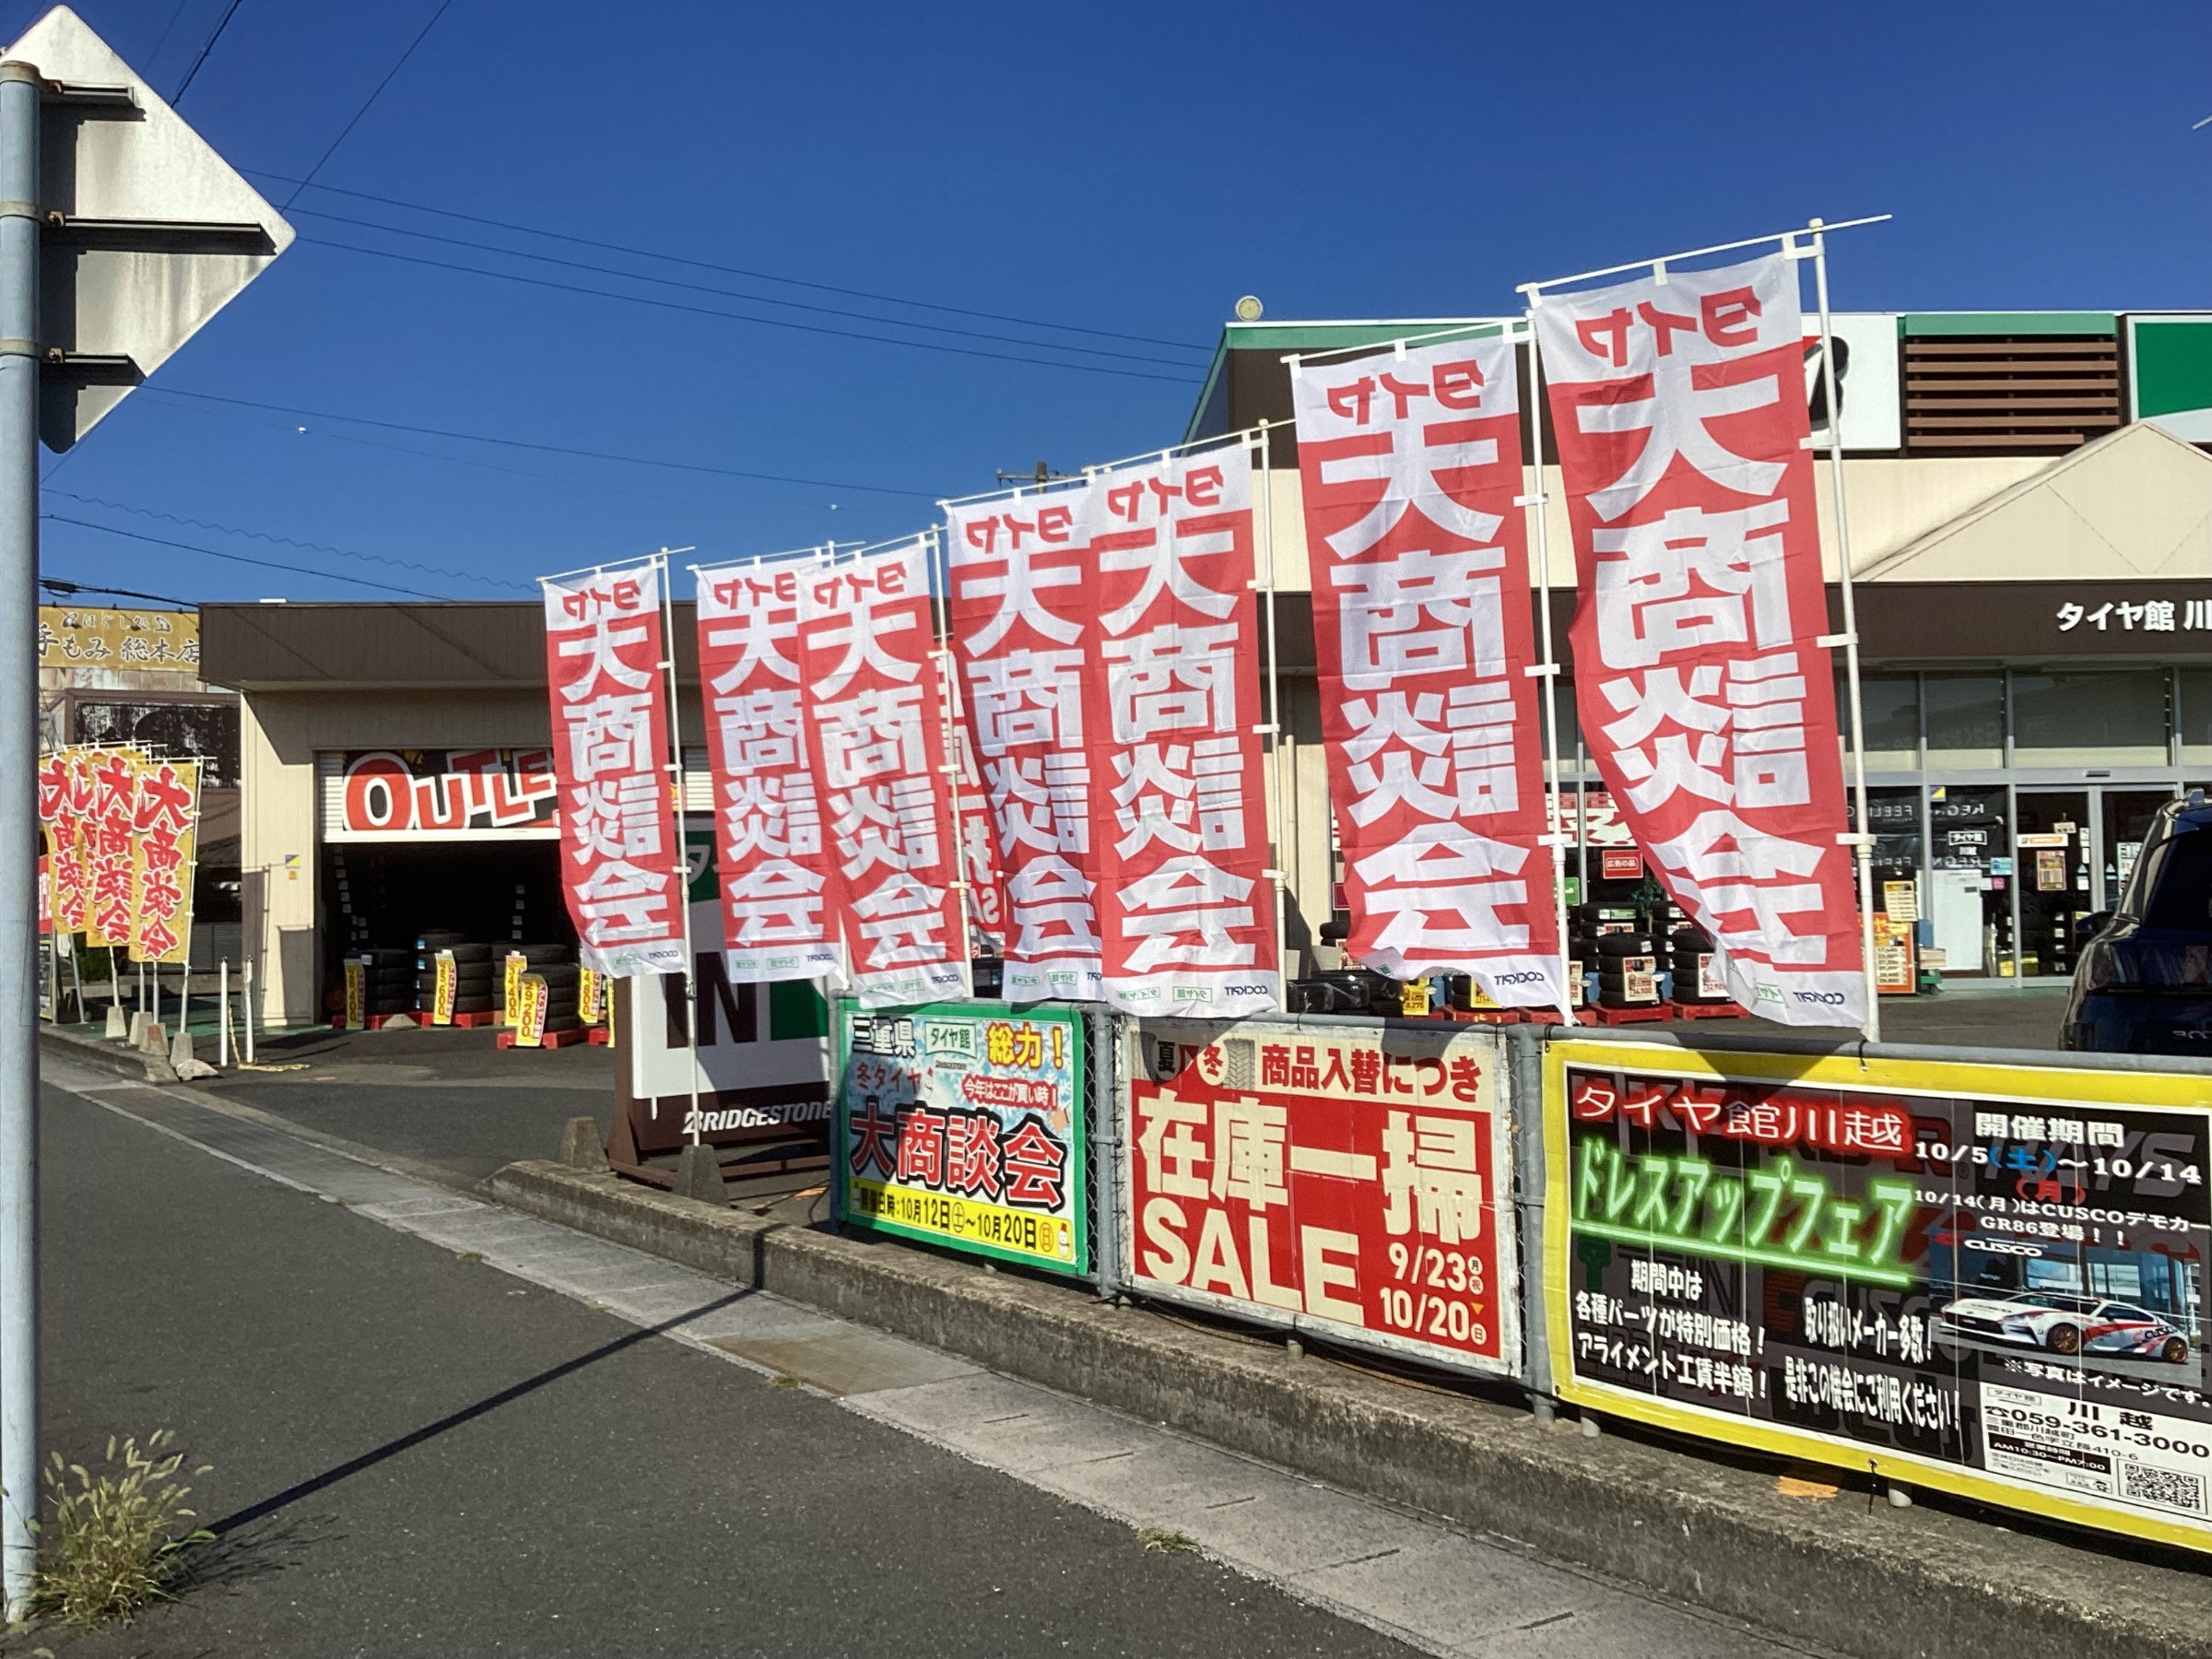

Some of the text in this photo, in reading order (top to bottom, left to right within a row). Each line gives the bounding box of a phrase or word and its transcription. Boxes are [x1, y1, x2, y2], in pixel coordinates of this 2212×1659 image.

[2056, 601, 2175, 631] タイヤ館
[343, 749, 558, 831] OUTLE
[852, 1017, 1065, 1069] 三重県 タイヤ館 総力！
[1158, 1041, 1483, 1103] 夏 冬 商品入替につき
[856, 1062, 921, 1094] 冬タイヤ
[1577, 1086, 1904, 1152] タイヤ館川越
[1974, 1112, 2124, 1148] 開催期間
[851, 1098, 1066, 1211] 大商談会
[1138, 1088, 1482, 1244] 在庫一掃
[1579, 1138, 1912, 1265] ドレスアップフェア
[1142, 1197, 1365, 1327] SALE
[1389, 1241, 1467, 1292] 9/23
[1631, 1259, 1703, 1301] 期間中は
[1380, 1287, 1470, 1342] 10/20
[1575, 1289, 1765, 1357] 各種パーツが特別価格！
[1578, 1332, 1767, 1399] アライメント工賃半額！
[2011, 1408, 2210, 1459] 059-361-3000
